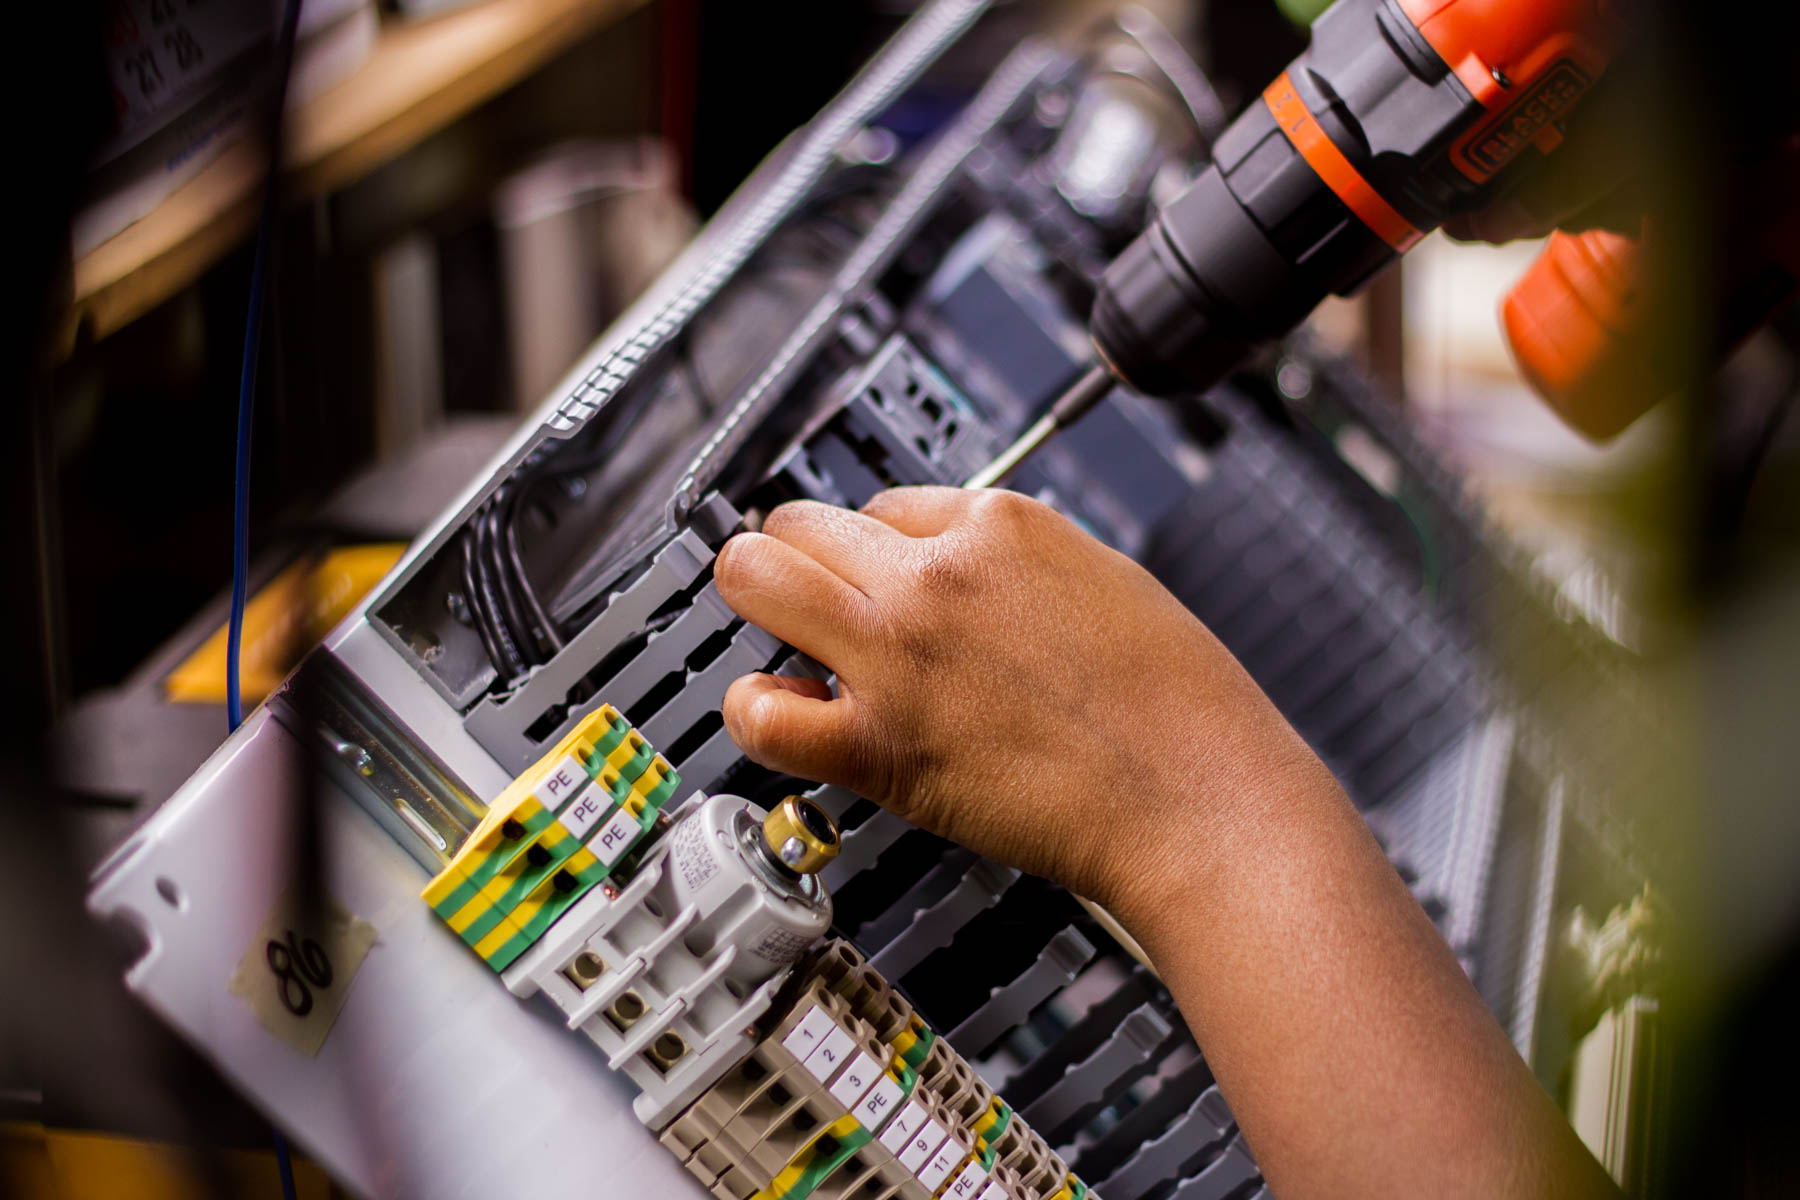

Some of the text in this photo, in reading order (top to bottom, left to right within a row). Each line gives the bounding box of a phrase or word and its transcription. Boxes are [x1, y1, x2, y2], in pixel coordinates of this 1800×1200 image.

[124, 45, 165, 98] 27
[162, 24, 204, 71] 28
[547, 770, 572, 795] PE
[574, 797, 598, 822] PE
[602, 824, 626, 849] PE
[267, 929, 334, 1017] 86
[803, 1028, 814, 1039] 1
[823, 1049, 835, 1062] 2
[850, 1075, 861, 1087] 3
[867, 1093, 887, 1114] PE
[897, 1120, 907, 1132] 7
[916, 1139, 928, 1151] 9
[935, 1157, 949, 1172] 11
[954, 1176, 973, 1197] PE
